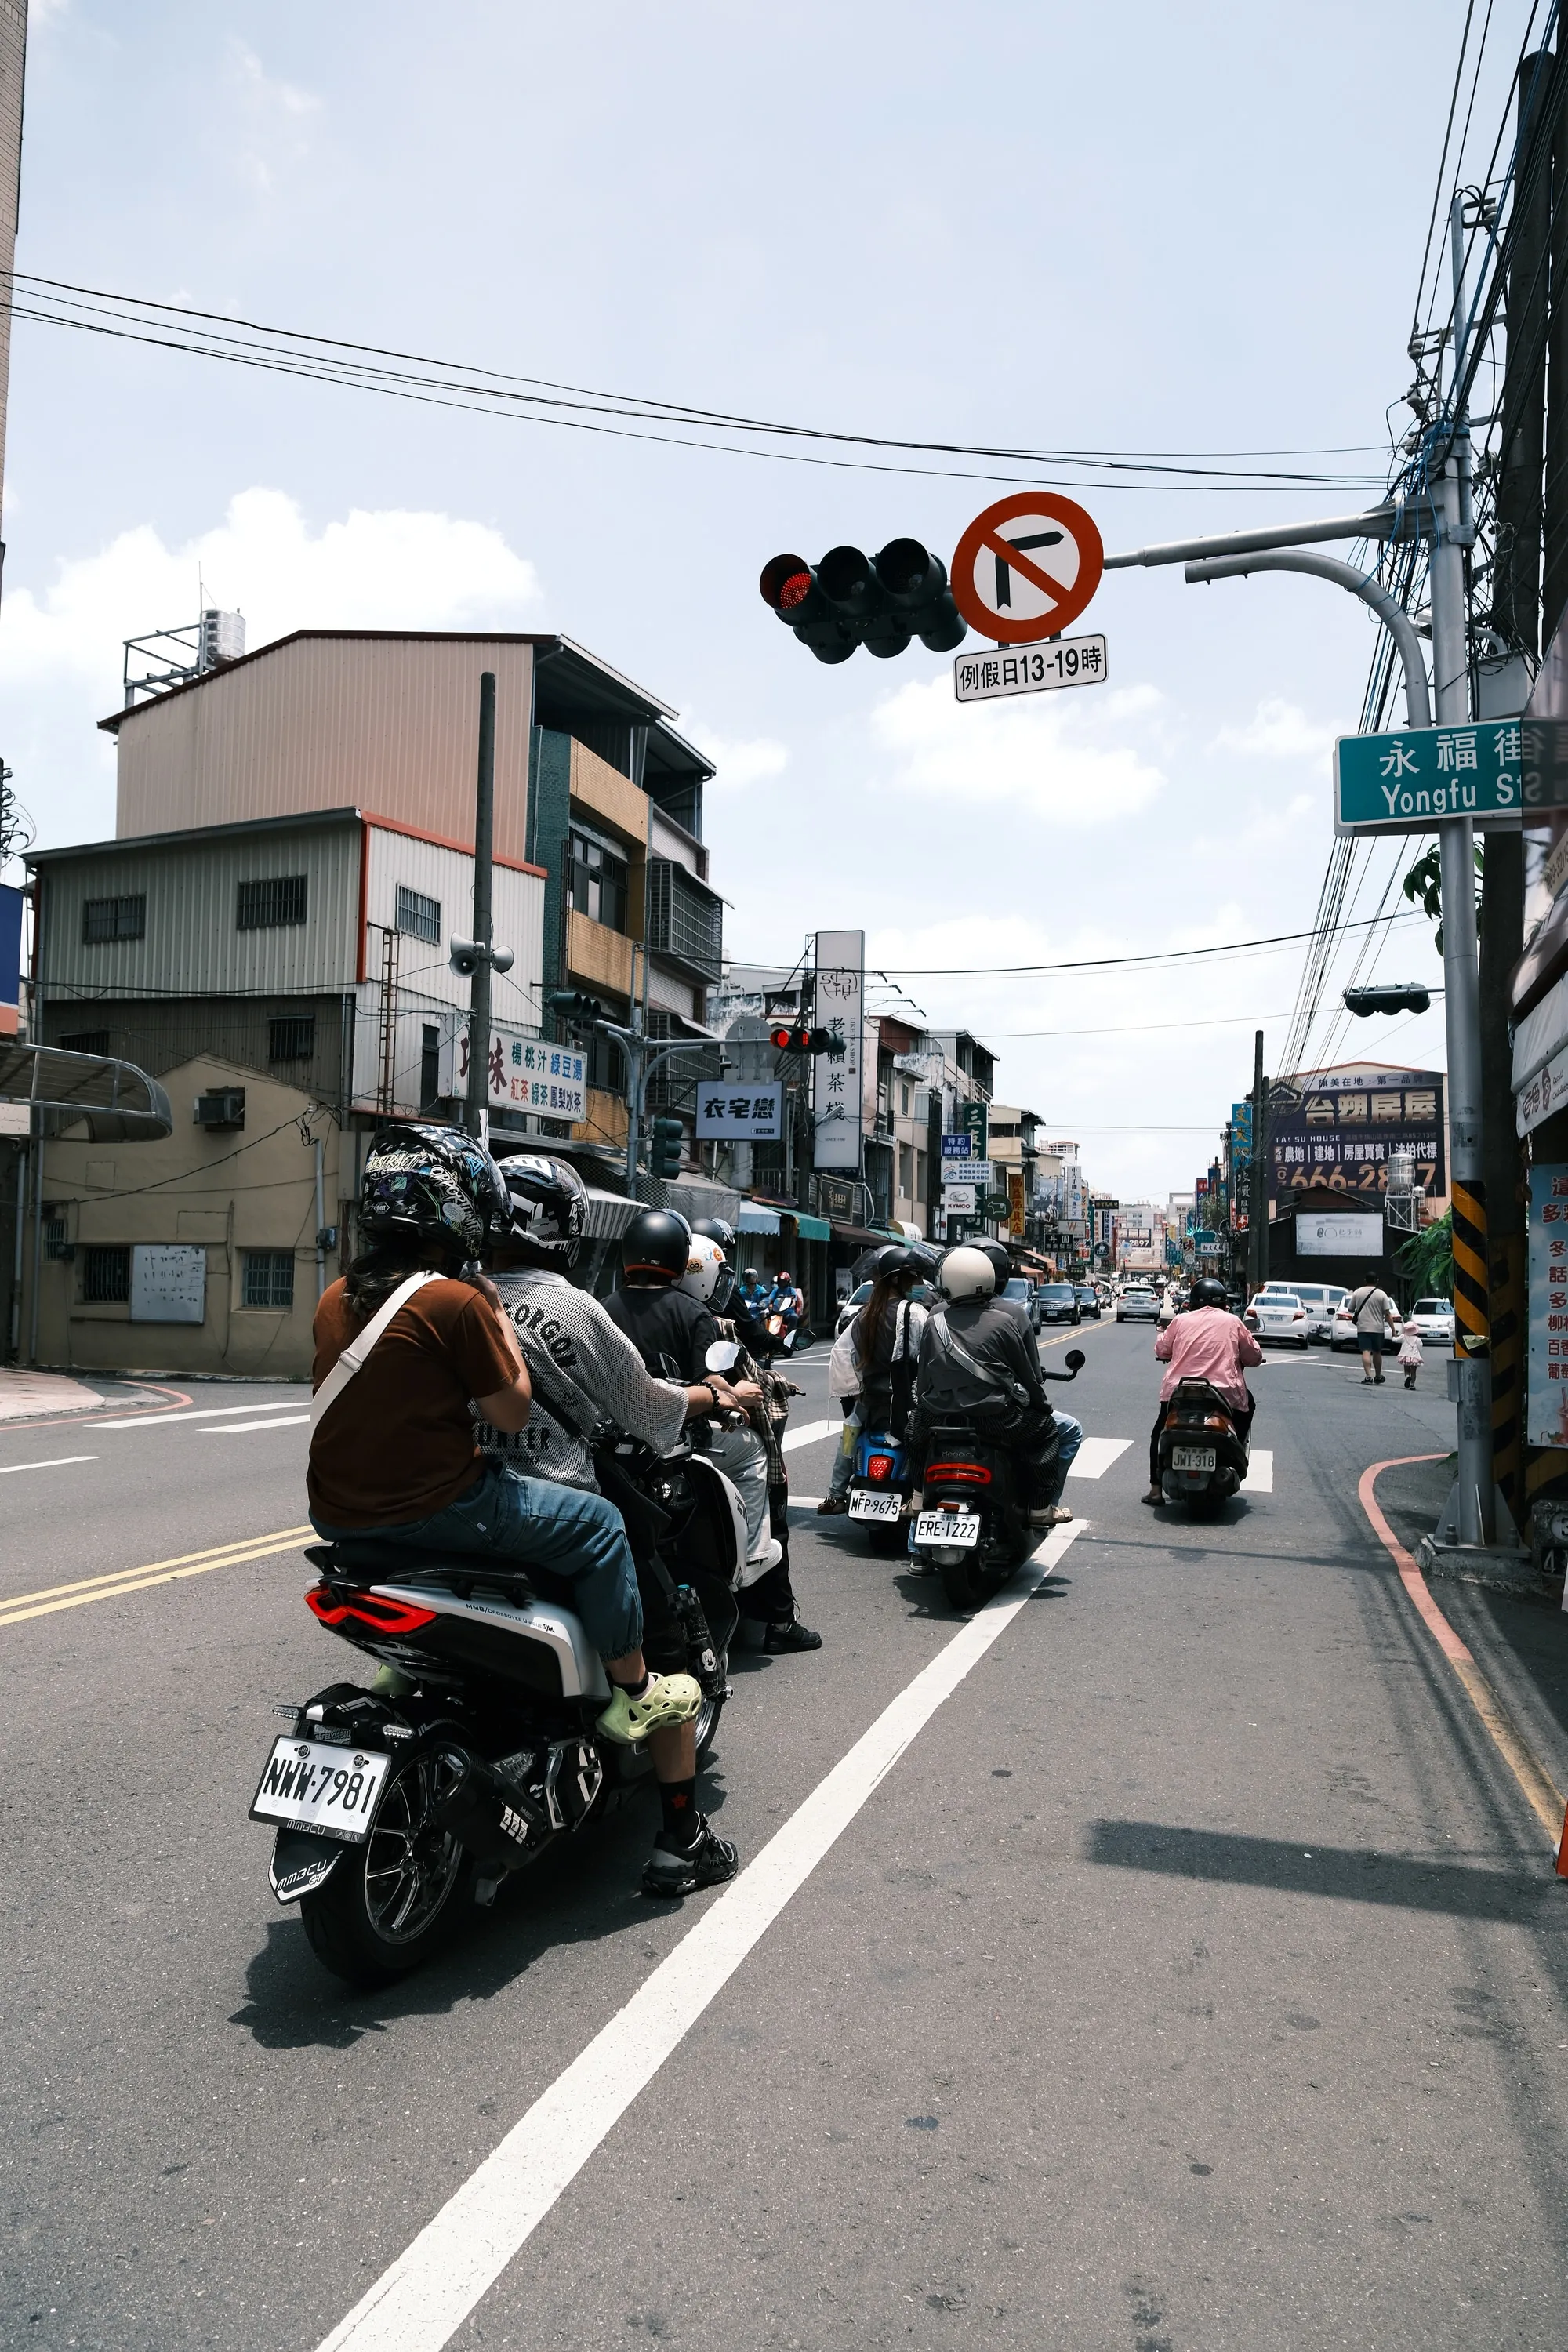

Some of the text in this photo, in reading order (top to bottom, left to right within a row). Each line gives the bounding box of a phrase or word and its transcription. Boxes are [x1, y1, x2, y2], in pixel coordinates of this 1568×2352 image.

[960, 645, 1102, 691] 例假日13-19時
[1381, 778, 1477, 814] Yongfu
[511, 1040, 583, 1082] 楊桃汁 綠豆湯
[510, 1076, 529, 1103] 紅茶
[531, 1081, 548, 1107] 綠茶
[703, 1098, 775, 1120] 衣宅戀
[1284, 1145, 1305, 1163] 農地
[1314, 1145, 1334, 1162] 建地
[1344, 1143, 1385, 1160] 房屋買賣
[543, 1623, 556, 1633] SYM
